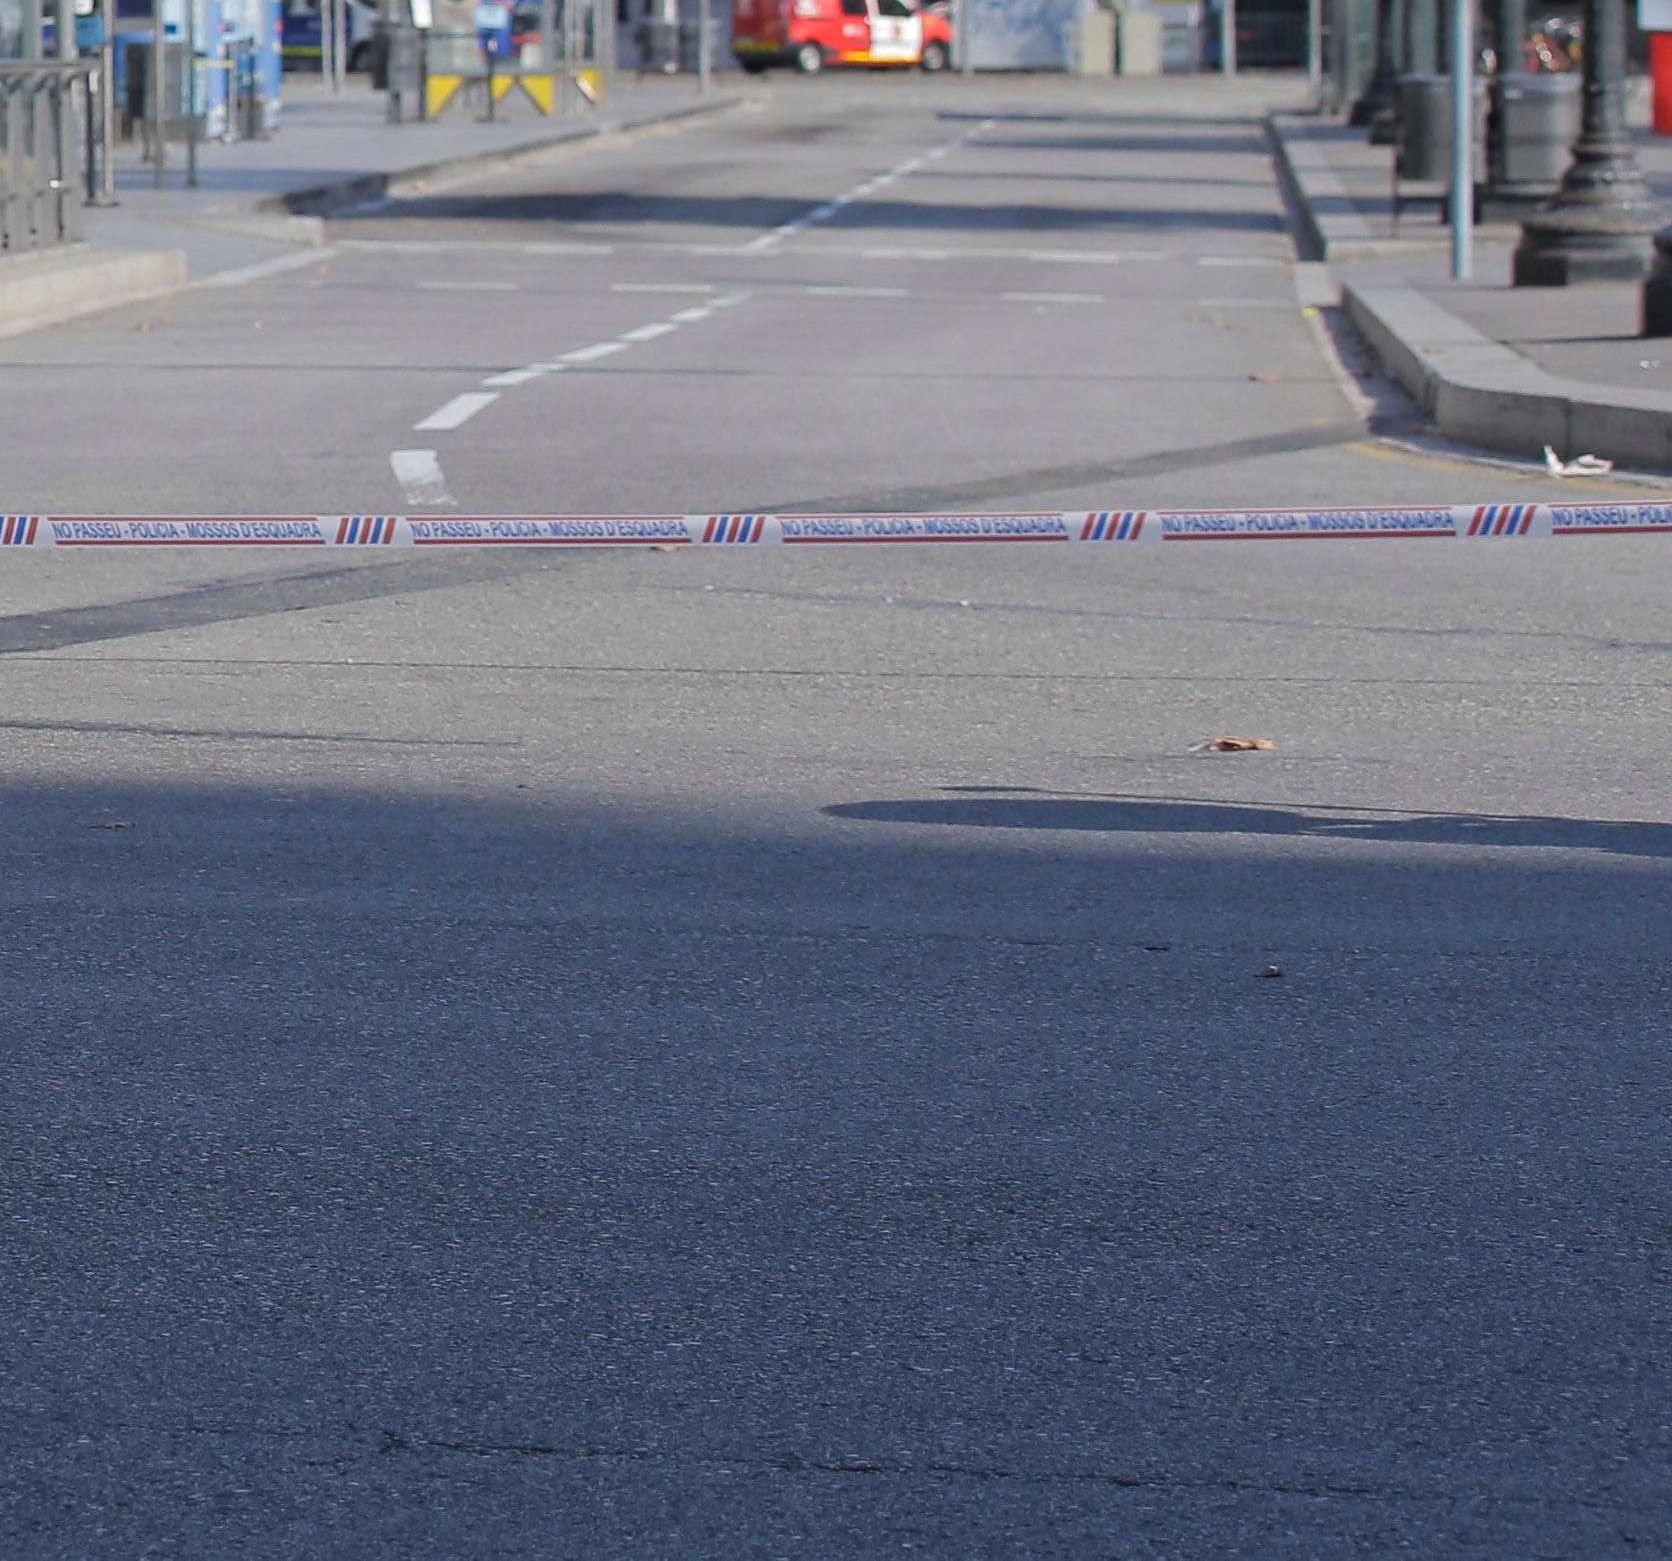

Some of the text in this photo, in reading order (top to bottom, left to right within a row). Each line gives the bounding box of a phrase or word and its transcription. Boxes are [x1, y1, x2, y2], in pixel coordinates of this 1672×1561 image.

[1163, 516, 1182, 532] NO
[1185, 516, 1236, 532] PASSEU
[1246, 515, 1297, 531] POLICIA
[1307, 514, 1366, 530] MOSSOS
[1367, 512, 1453, 529] D'ESQUADRA
[1553, 510, 1571, 526] NO
[1574, 509, 1628, 525] PASSEU
[52, 522, 71, 537] NO
[74, 522, 122, 537] PASSEU
[130, 522, 179, 538] POLICIA
[185, 522, 239, 538] MOSSOS
[242, 522, 321, 538] D'ESQUADRA
[411, 522, 430, 537] NO
[434, 522, 482, 537] PASSEU
[490, 522, 539, 537] POLICIA
[548, 521, 605, 537] MOSSOS
[608, 521, 689, 537] D'ESQUADRA
[781, 520, 800, 535] NO
[803, 520, 854, 535] PASSEU
[864, 520, 915, 535] POLICIA
[923, 519, 981, 534] MOSSOS
[983, 518, 1067, 534] D'ESQUADRA
